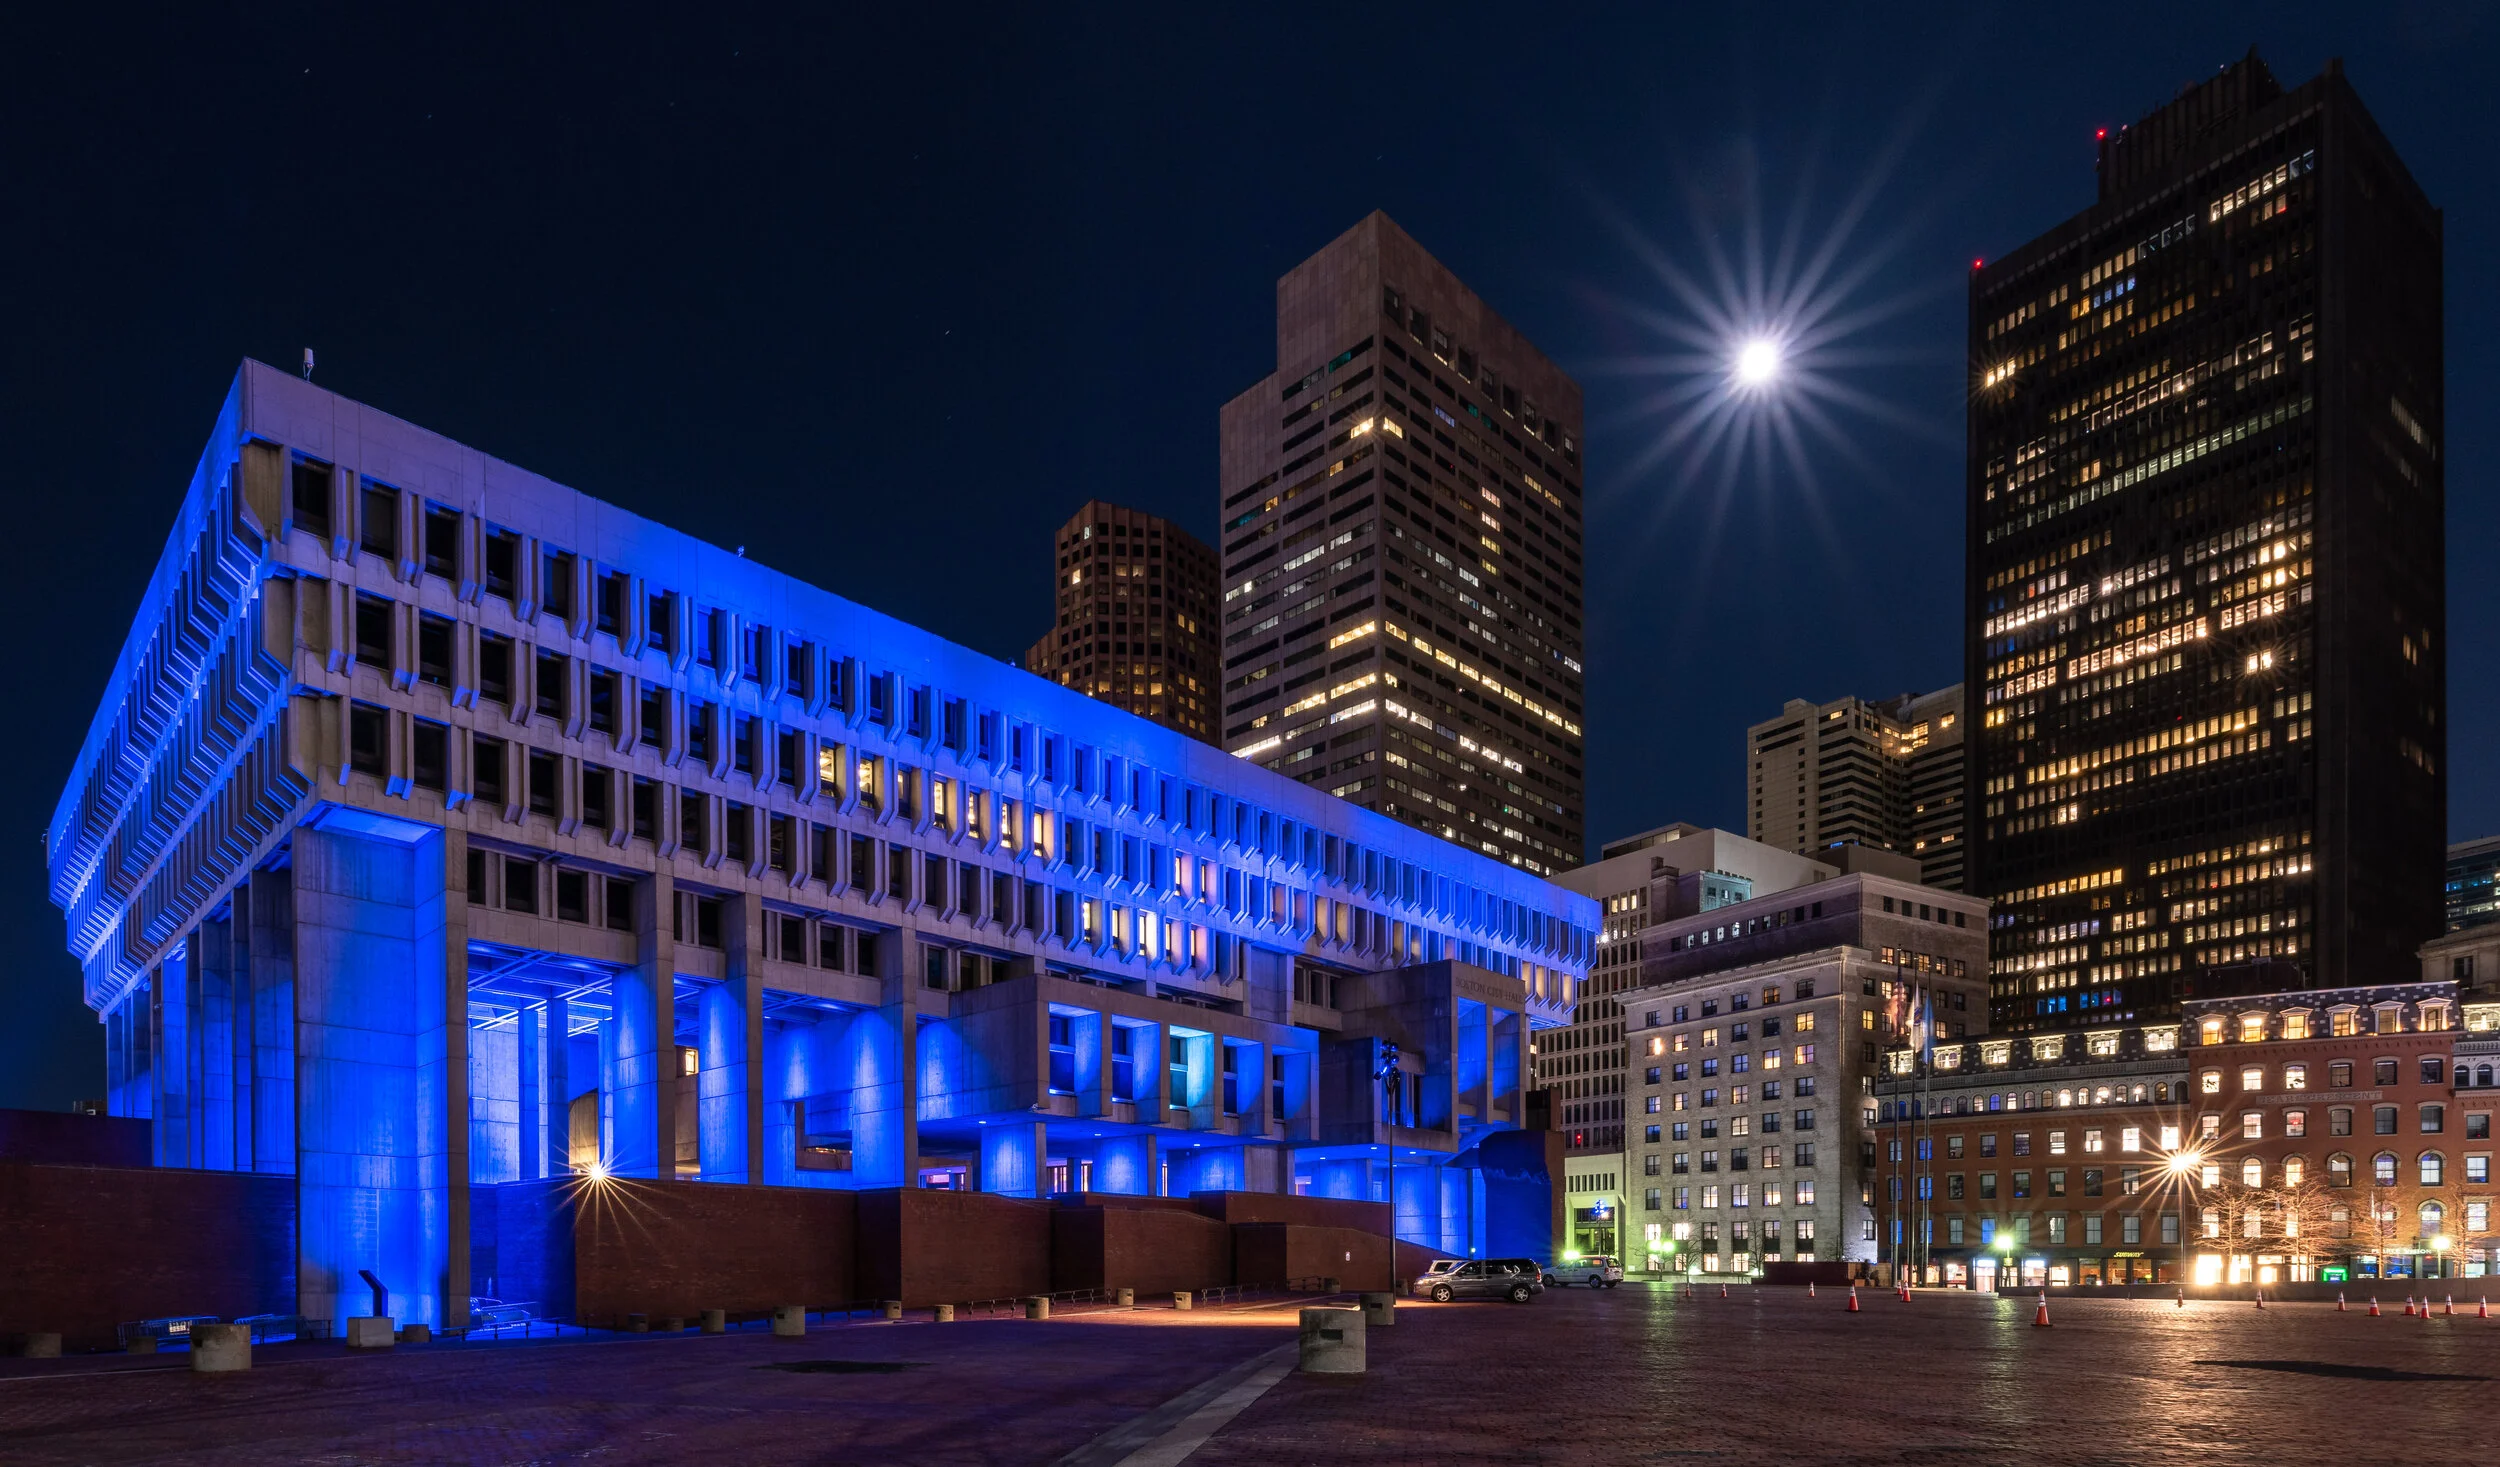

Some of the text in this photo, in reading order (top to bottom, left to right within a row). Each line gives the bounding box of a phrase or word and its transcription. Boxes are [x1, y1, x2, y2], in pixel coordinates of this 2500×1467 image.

[1456, 977, 1524, 1004] BOSTON CITY HALL
